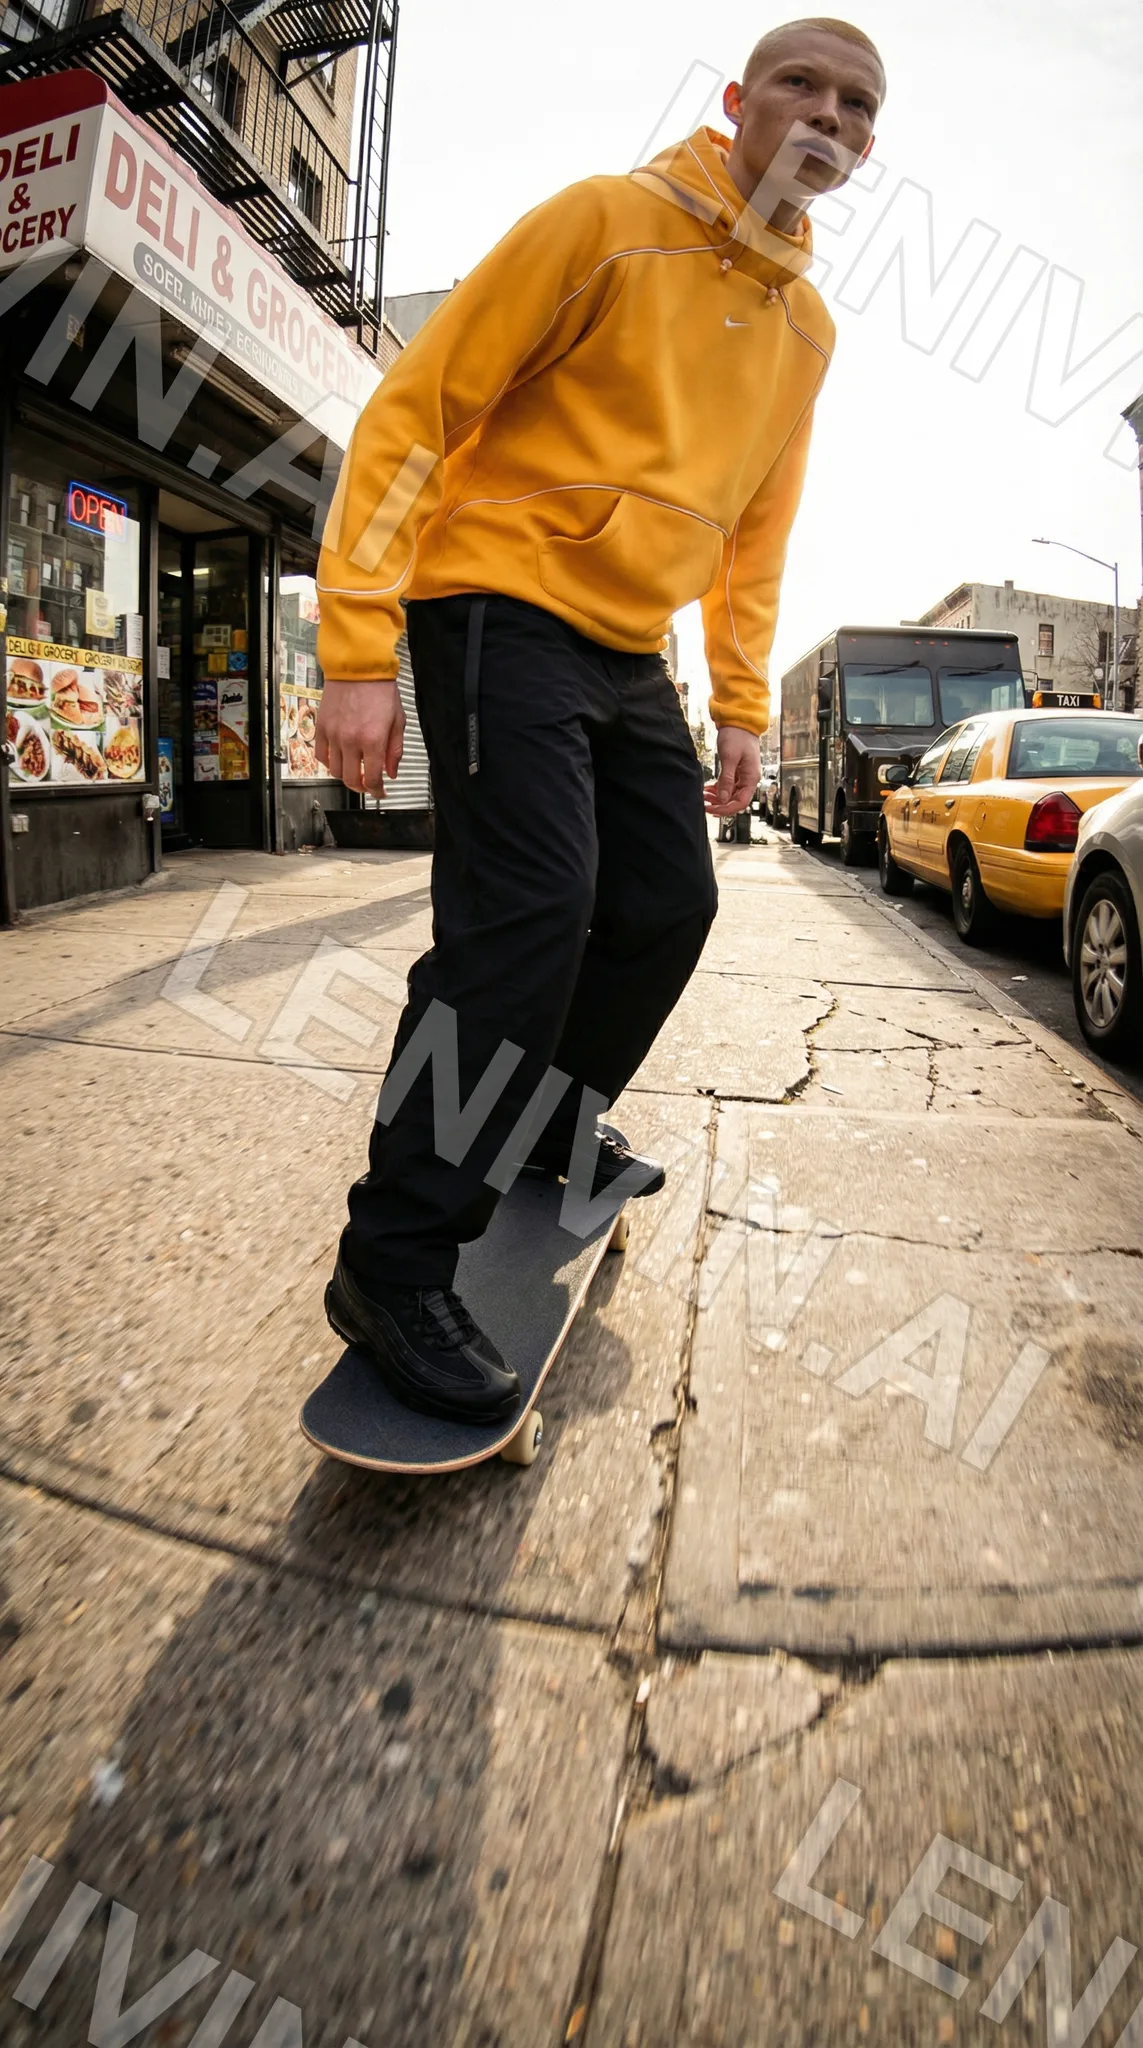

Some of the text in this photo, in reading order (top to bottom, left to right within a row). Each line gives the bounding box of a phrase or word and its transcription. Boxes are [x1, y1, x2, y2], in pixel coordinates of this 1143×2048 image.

[8, 182, 31, 214] &
[105, 130, 363, 395] DELI & GROCERY
[70, 489, 125, 536] OPEN
[1057, 694, 1080, 707] TAXI
